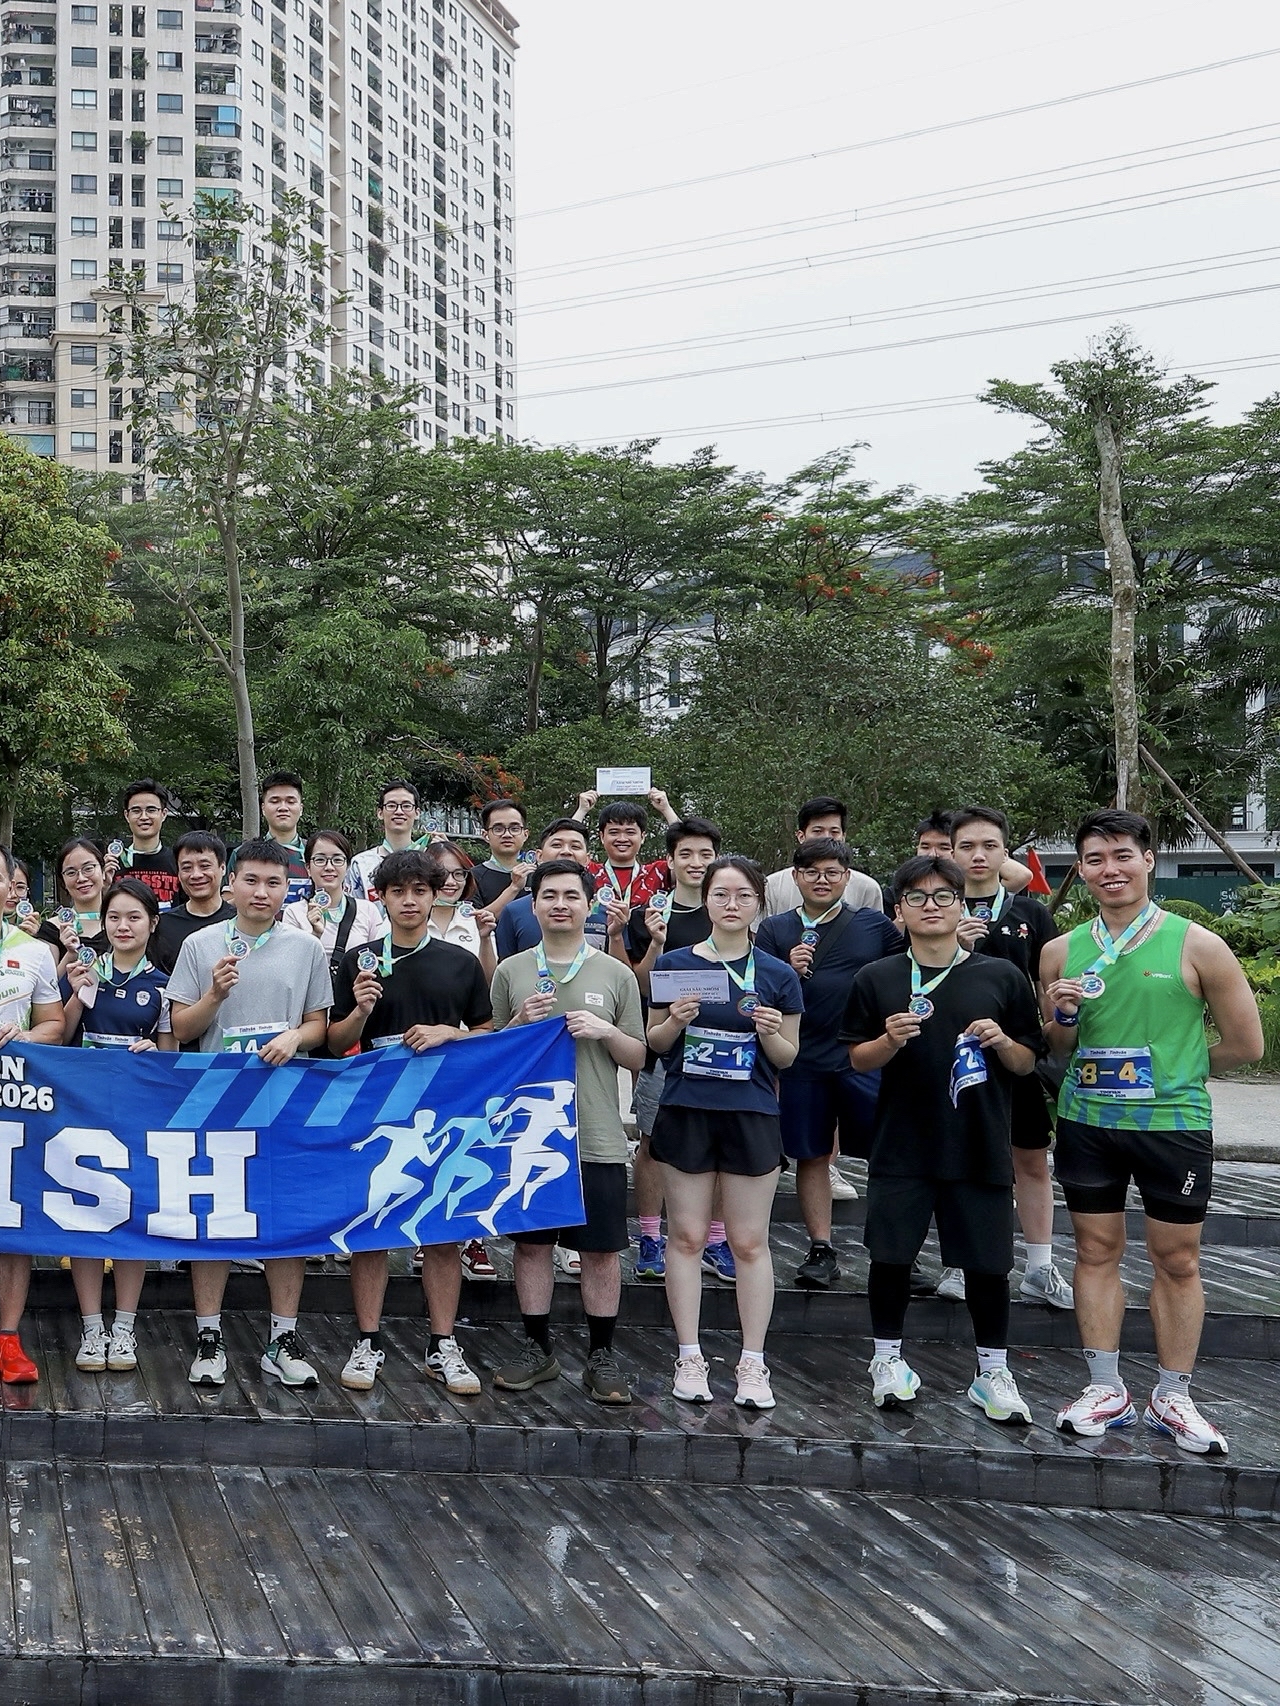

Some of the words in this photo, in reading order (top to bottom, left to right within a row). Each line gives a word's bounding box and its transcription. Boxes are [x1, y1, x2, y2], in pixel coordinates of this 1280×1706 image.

[698, 1042, 743, 1067] 2-1
[1082, 1061, 1138, 1084] 8-4
[1181, 1170, 1197, 1196] ECHT
